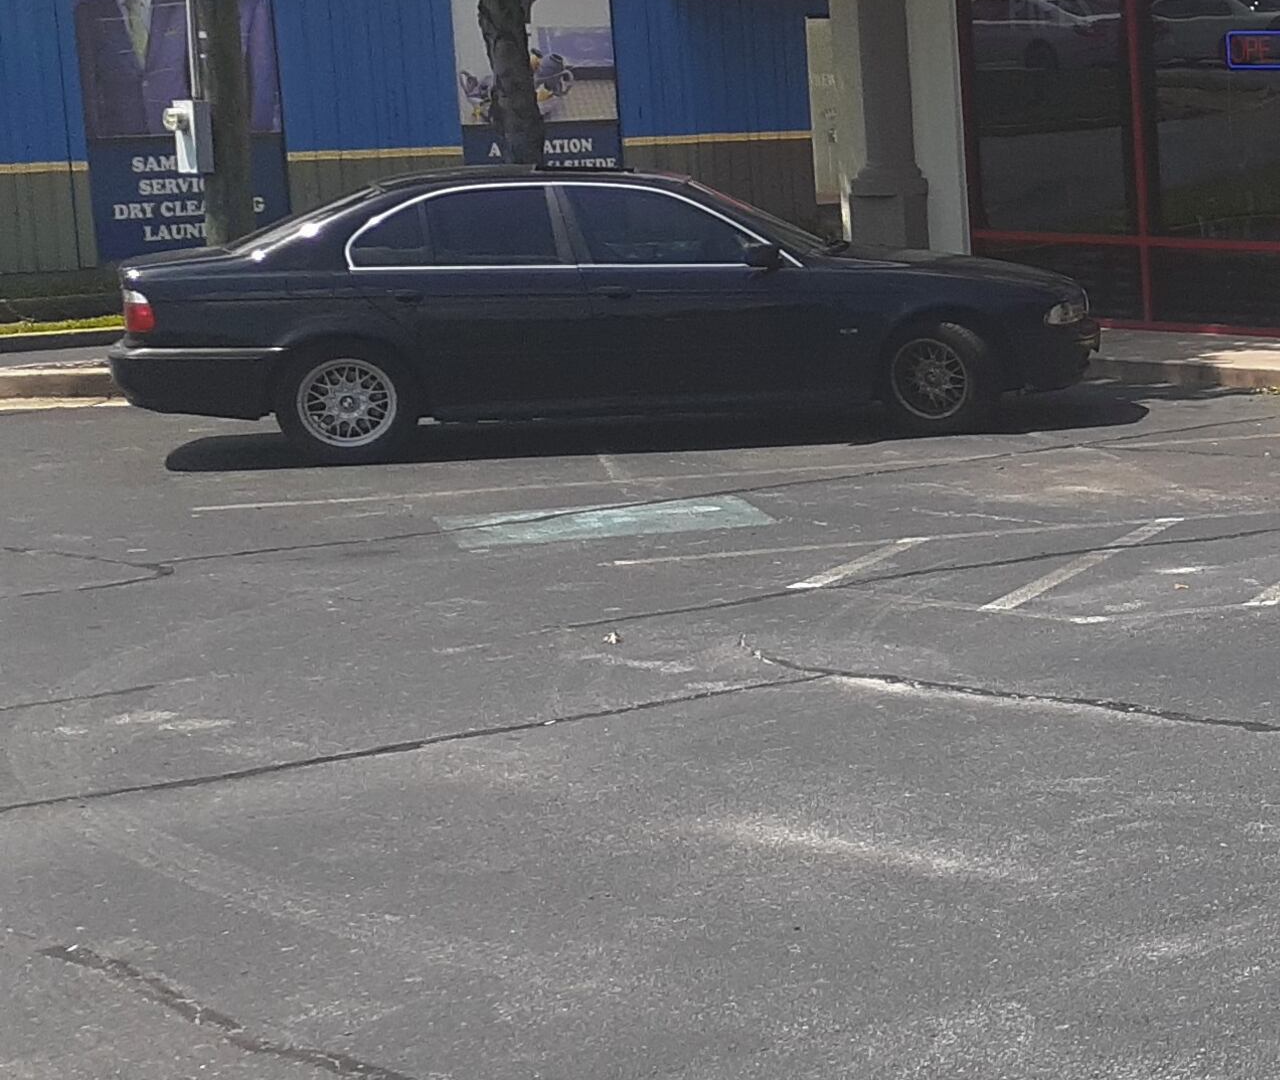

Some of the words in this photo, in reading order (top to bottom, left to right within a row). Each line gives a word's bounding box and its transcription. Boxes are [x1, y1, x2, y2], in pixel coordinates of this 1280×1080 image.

[131, 156, 177, 173] SAM
[138, 177, 205, 196] SERVI
[113, 202, 156, 220] DRY
[143, 222, 208, 242] LAUN
